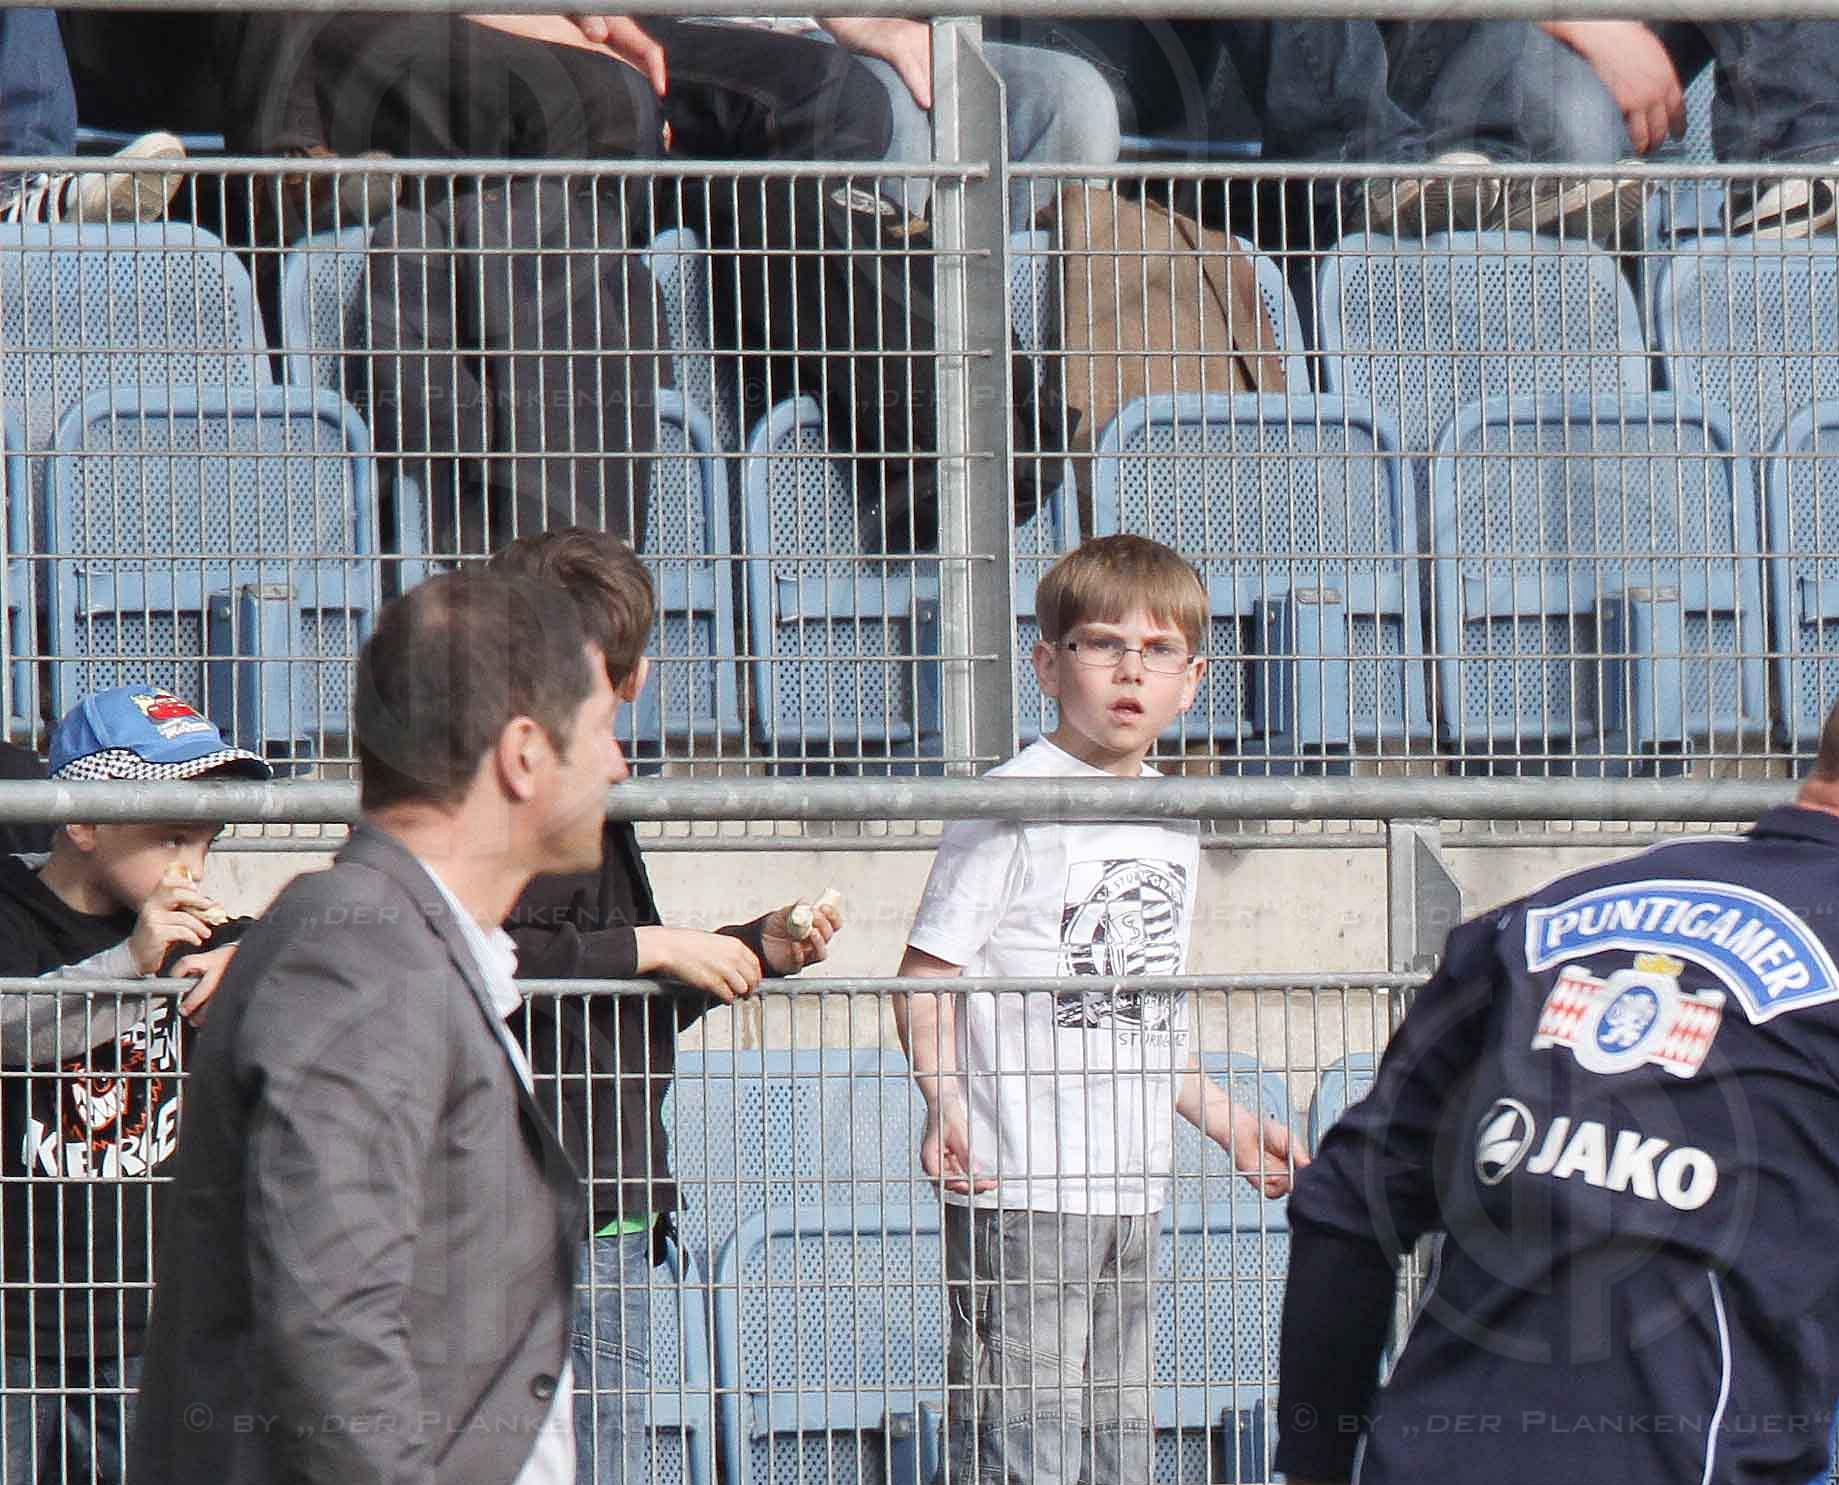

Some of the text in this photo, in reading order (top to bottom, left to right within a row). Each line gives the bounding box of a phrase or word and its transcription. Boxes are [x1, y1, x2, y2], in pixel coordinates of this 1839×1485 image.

[1547, 896, 1811, 1000] PUNTIGAMER
[22, 1096, 183, 1179] KERLE
[1526, 1116, 1718, 1211] JAKO
